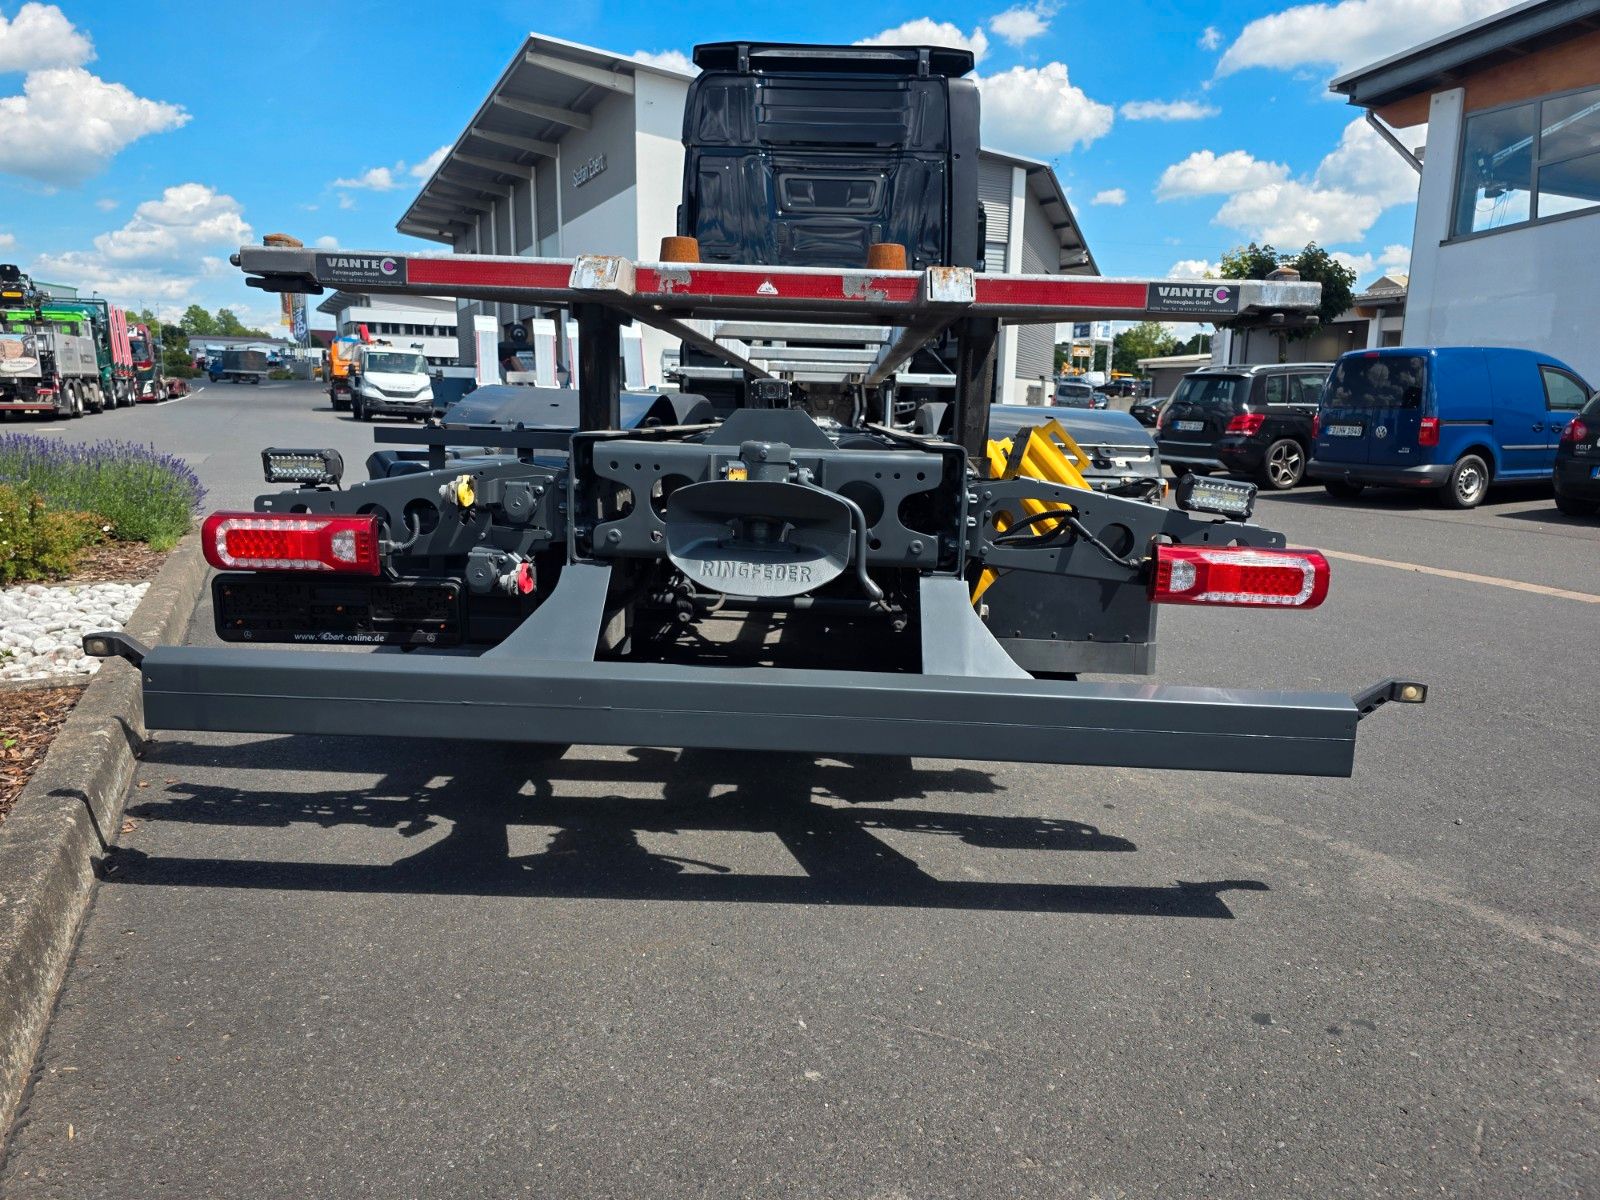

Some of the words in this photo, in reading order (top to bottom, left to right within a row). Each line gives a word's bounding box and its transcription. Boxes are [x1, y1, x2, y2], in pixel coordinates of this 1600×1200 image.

[325, 257, 398, 276] VANTEC
[1158, 285, 1231, 304] VANTEC
[700, 560, 812, 583] RINGFEDER
